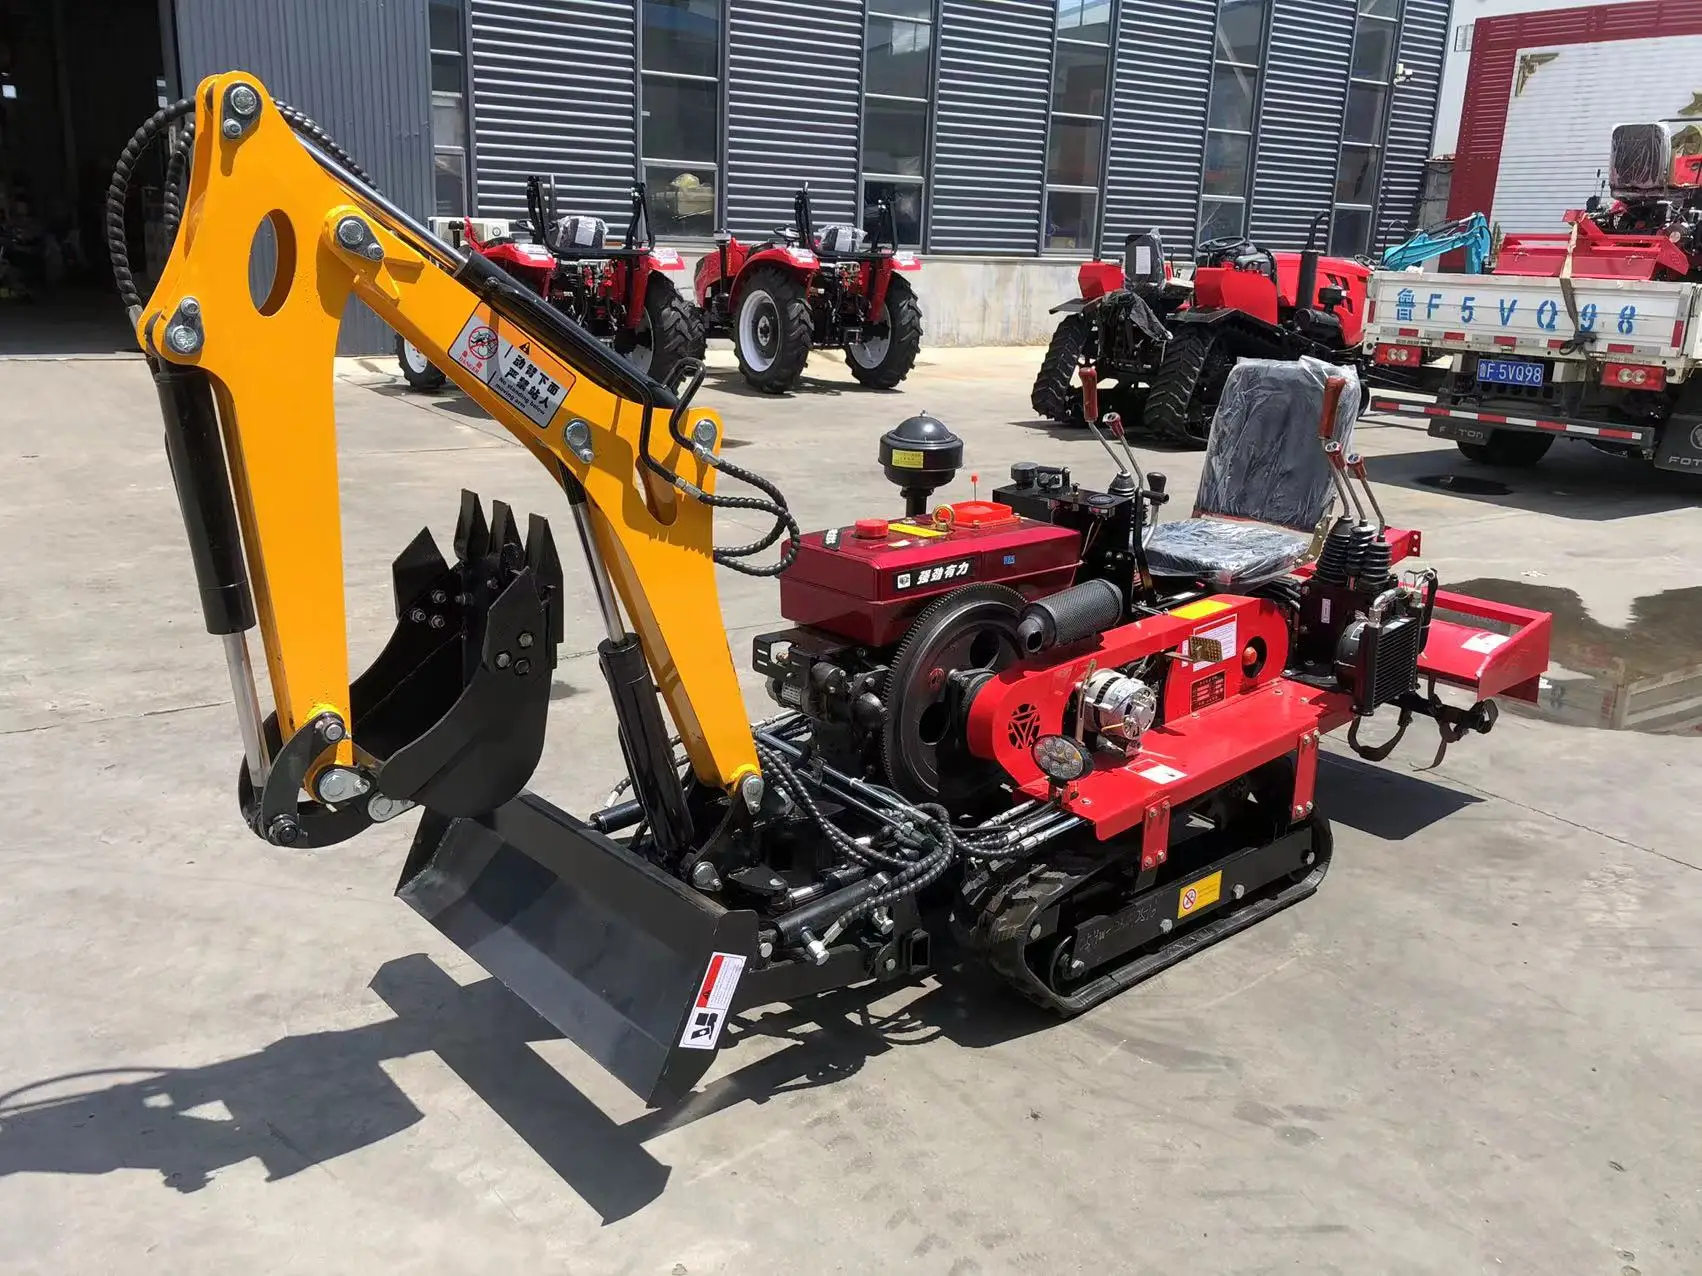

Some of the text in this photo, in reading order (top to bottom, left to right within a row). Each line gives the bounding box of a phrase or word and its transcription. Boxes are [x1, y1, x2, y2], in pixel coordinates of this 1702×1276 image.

[504, 366, 548, 408] 严禁站人
[512, 354, 560, 396] 动臂下面
[495, 383, 526, 409] moving arm
[498, 376, 546, 415] No standing below
[916, 561, 969, 585] 强劲有力
